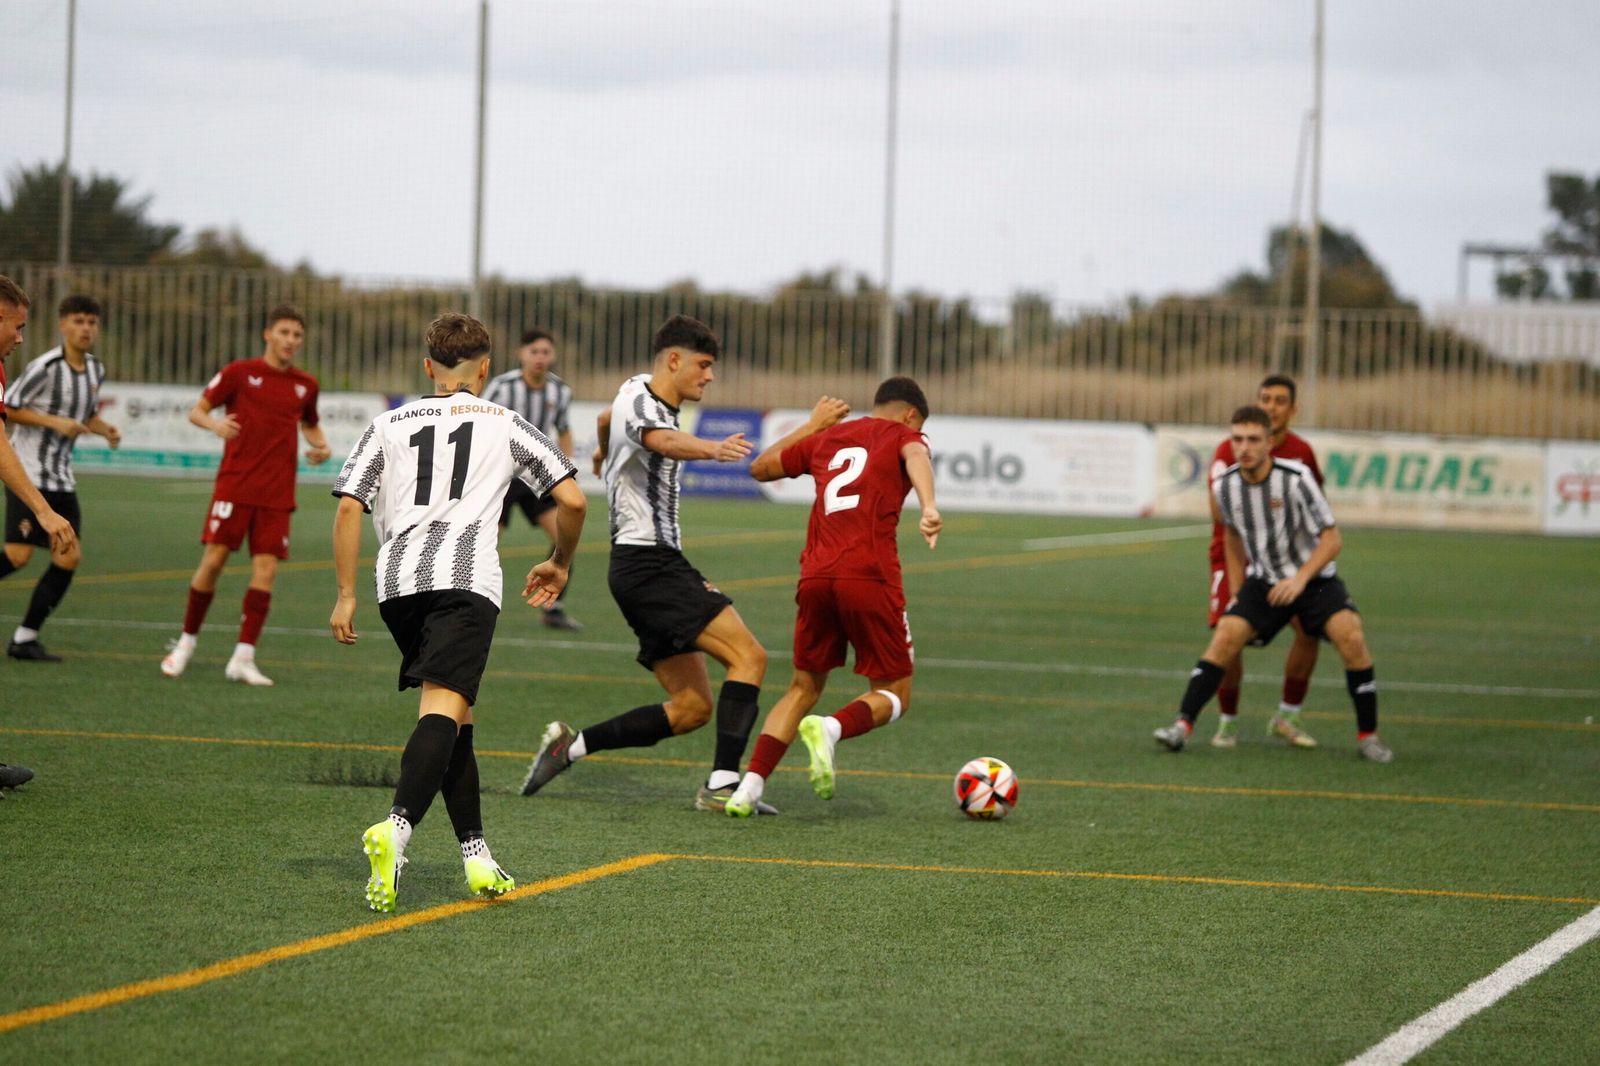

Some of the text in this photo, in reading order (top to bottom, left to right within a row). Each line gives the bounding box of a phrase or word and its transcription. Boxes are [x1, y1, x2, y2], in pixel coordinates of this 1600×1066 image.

[390, 404, 505, 424] BLANCOS RESOLFIX
[409, 421, 474, 506] 11
[823, 446, 868, 516] 2
